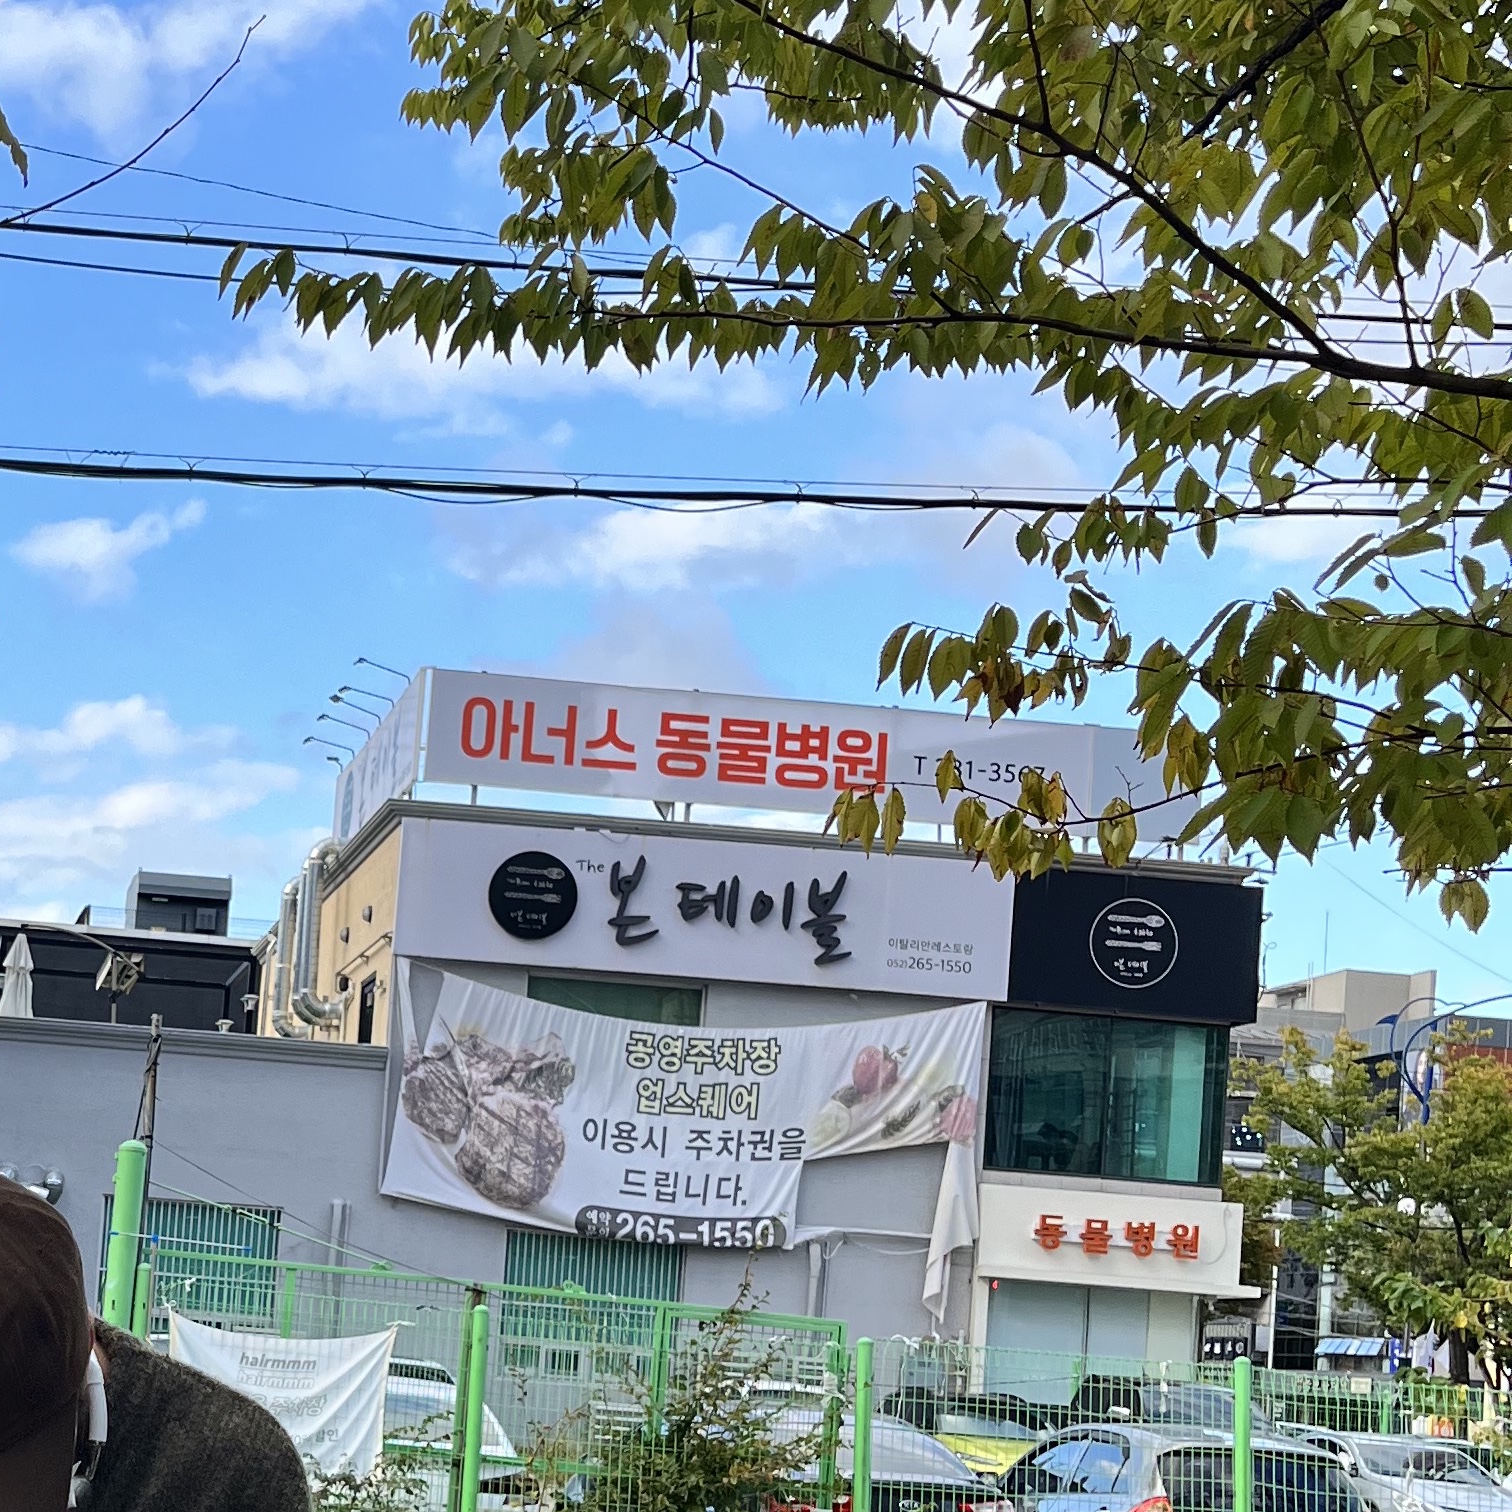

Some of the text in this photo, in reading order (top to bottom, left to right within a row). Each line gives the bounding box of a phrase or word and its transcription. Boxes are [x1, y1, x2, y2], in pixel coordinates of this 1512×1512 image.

[460, 696, 638, 771] 아너스
[655, 711, 889, 794] 동물병원
[913, 755, 928, 775] T
[576, 859, 606, 874] The
[608, 854, 660, 946] 본
[626, 1030, 781, 1076] 공영주차장
[636, 1077, 760, 1120] 업스퀘어
[582, 1118, 806, 1161] 이용시 주차권을
[619, 1168, 747, 1206] 드립니다.
[615, 1212, 775, 1248] 265-1550
[1034, 1214, 1200, 1260] 동물병원
[238, 1370, 316, 1389] hairmmm
[239, 1352, 317, 1371] hairmmm
